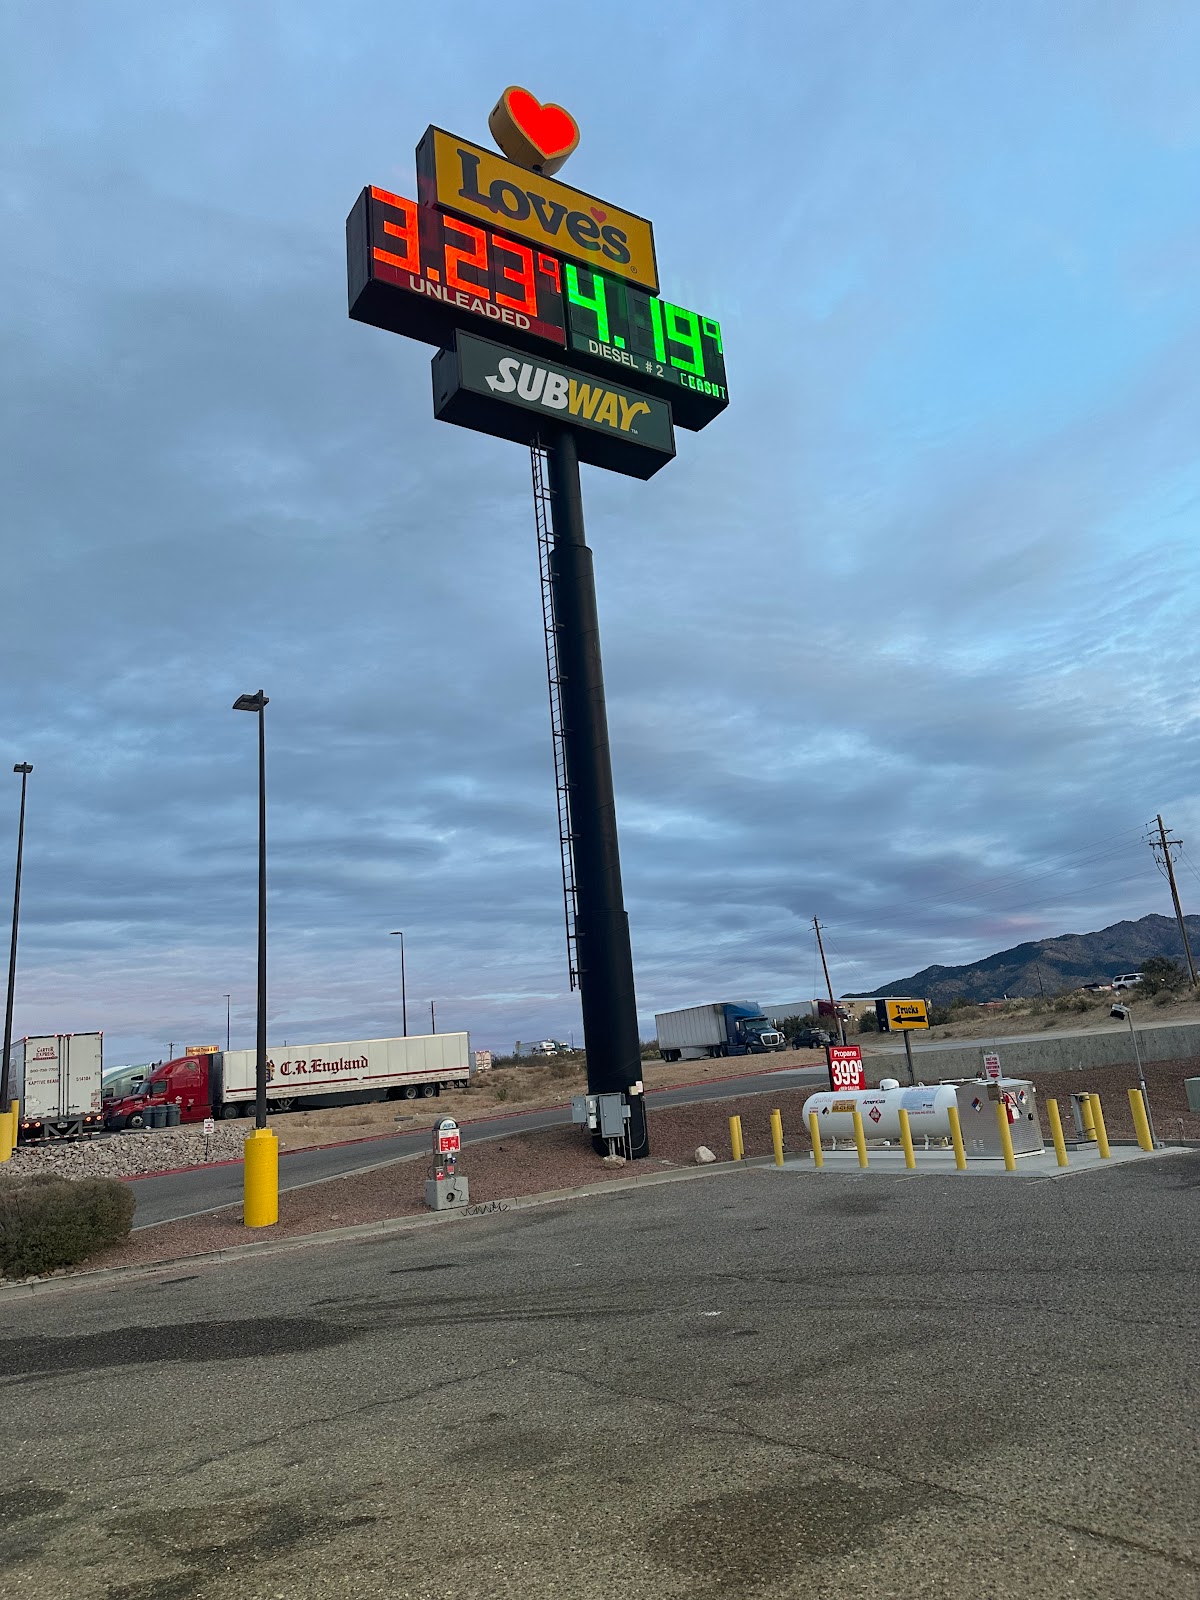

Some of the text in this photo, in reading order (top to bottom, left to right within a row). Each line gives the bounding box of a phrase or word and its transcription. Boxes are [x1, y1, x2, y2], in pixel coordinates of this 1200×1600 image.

[409, 275, 531, 330] UNLEADED
[588, 339, 639, 369] DIESEL
[485, 357, 651, 432] SUBWAY
[896, 1004, 919, 1015] Trucks
[833, 1049, 857, 1059] Propane
